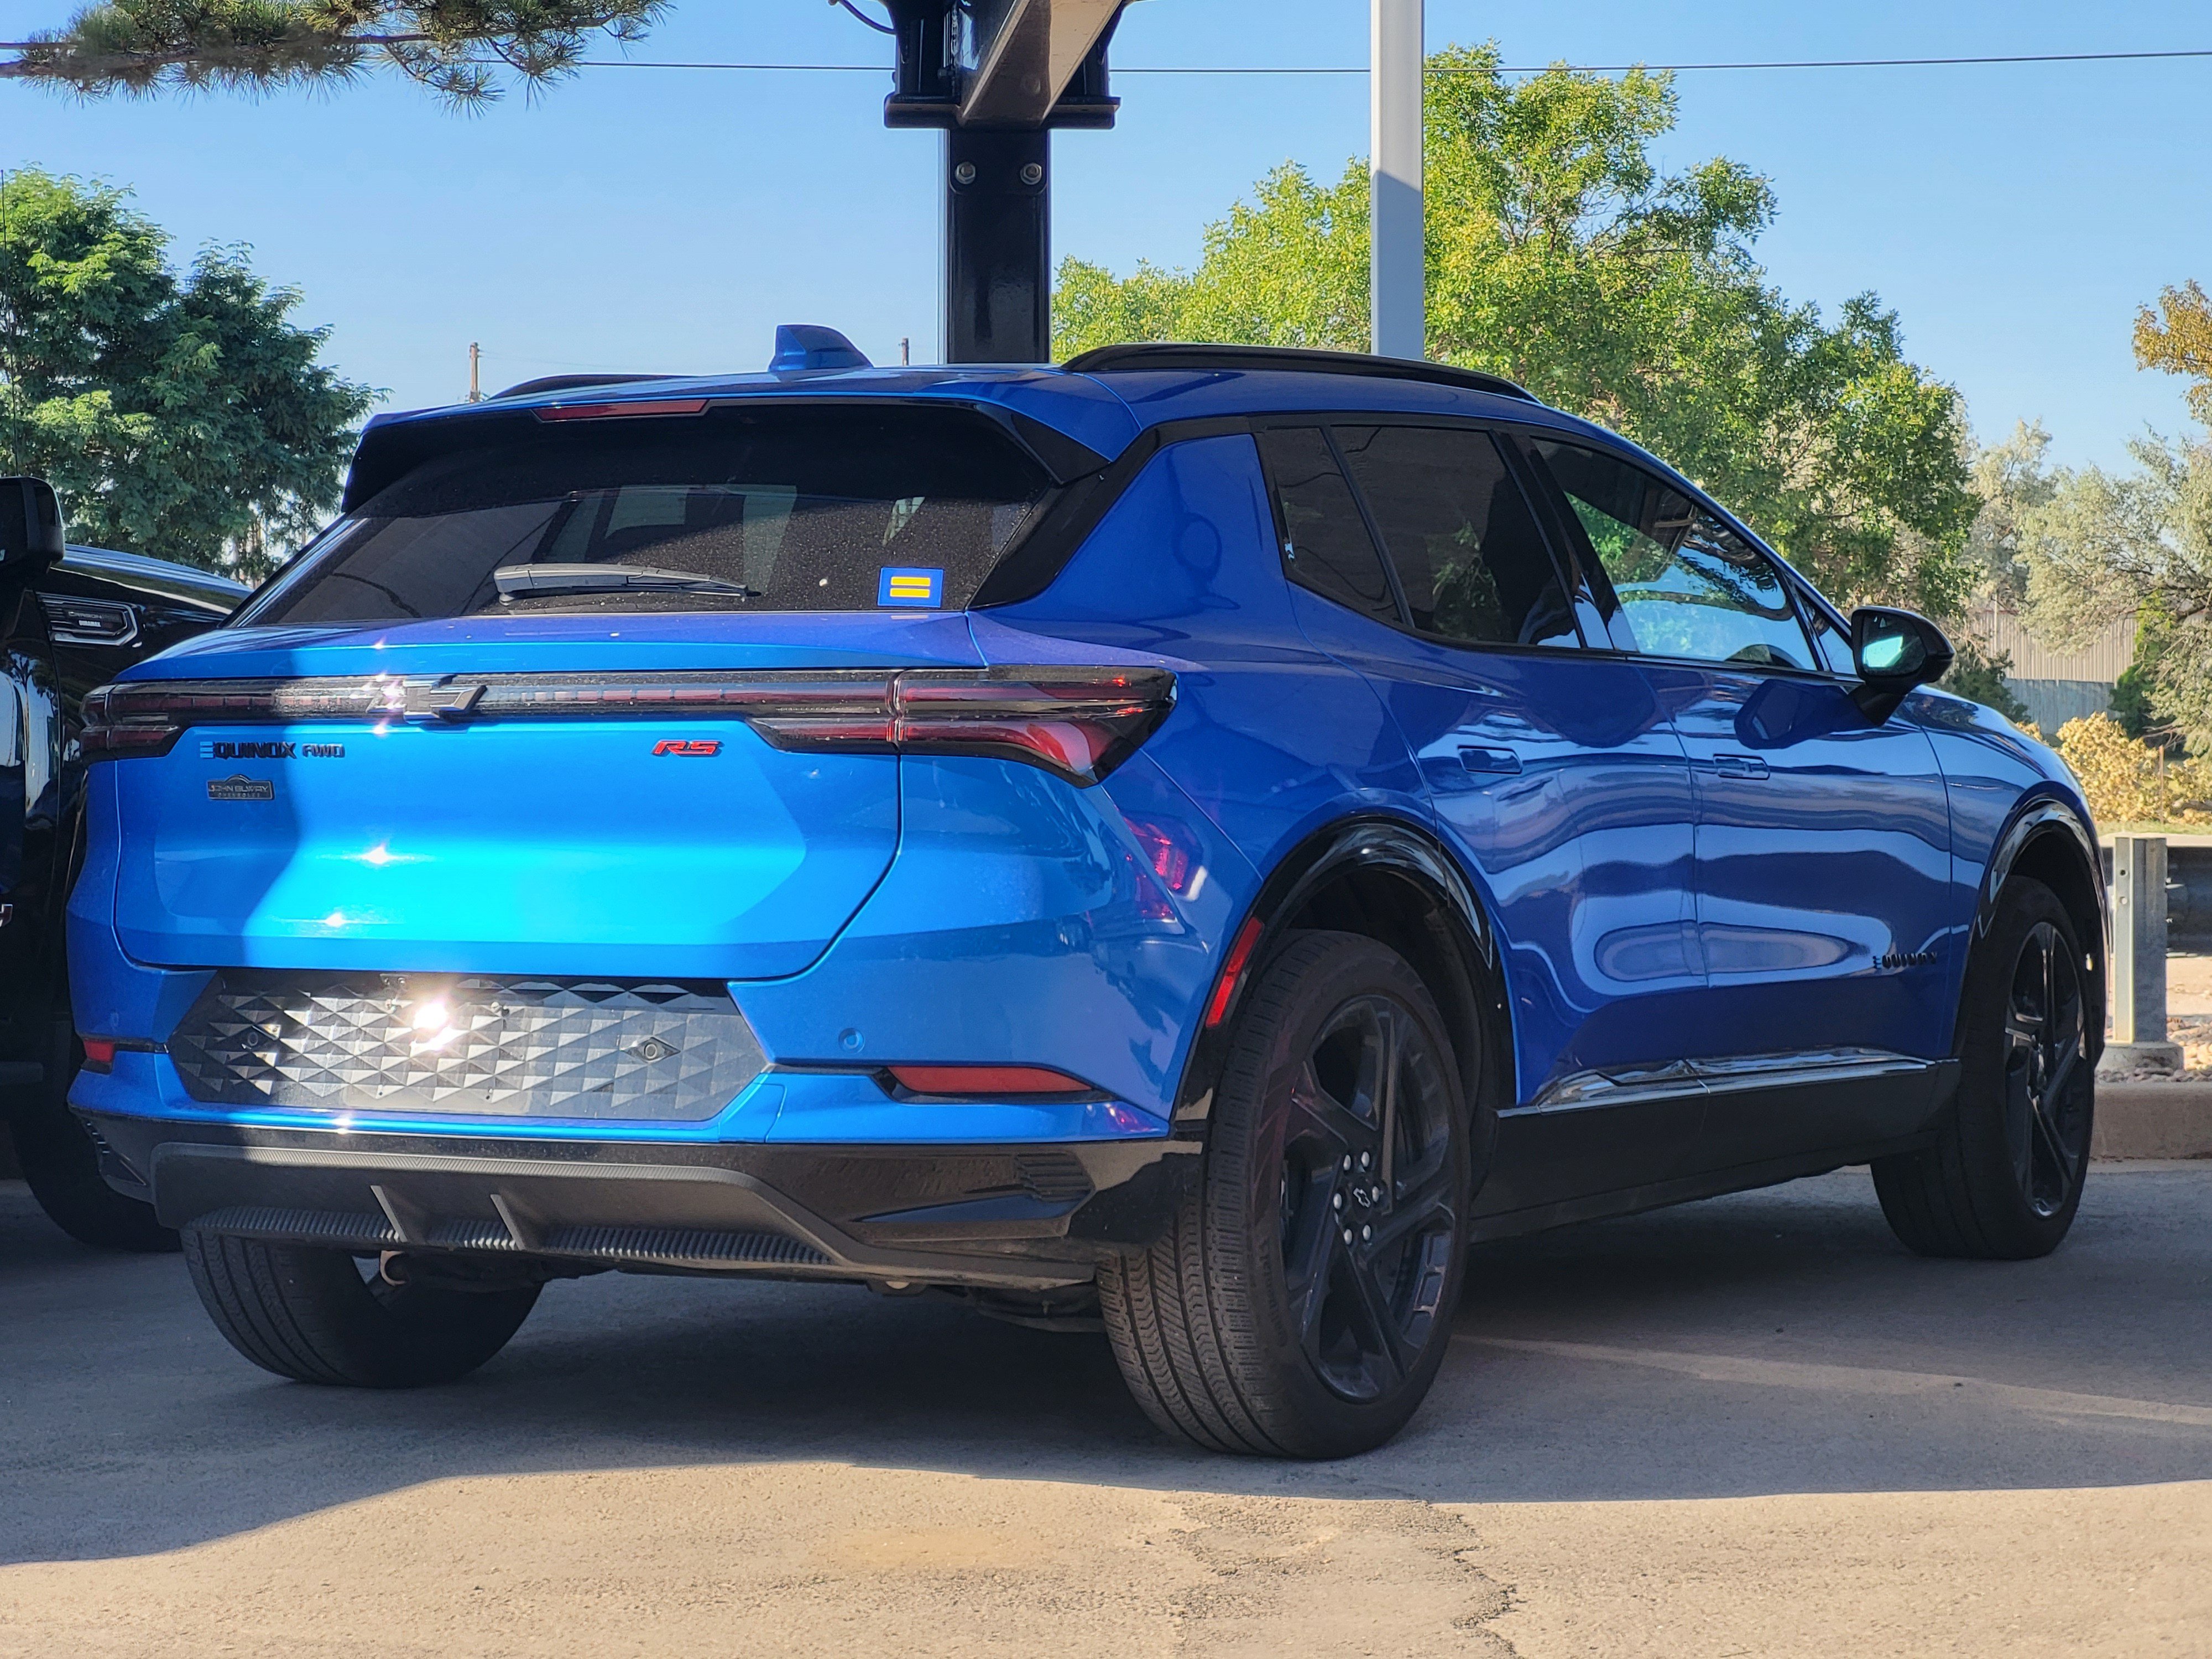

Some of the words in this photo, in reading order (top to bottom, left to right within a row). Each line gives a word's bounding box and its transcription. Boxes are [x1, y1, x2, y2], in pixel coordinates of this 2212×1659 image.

[200, 741, 296, 759] EQUINOX
[302, 743, 345, 758] FWD
[651, 739, 722, 757] RS
